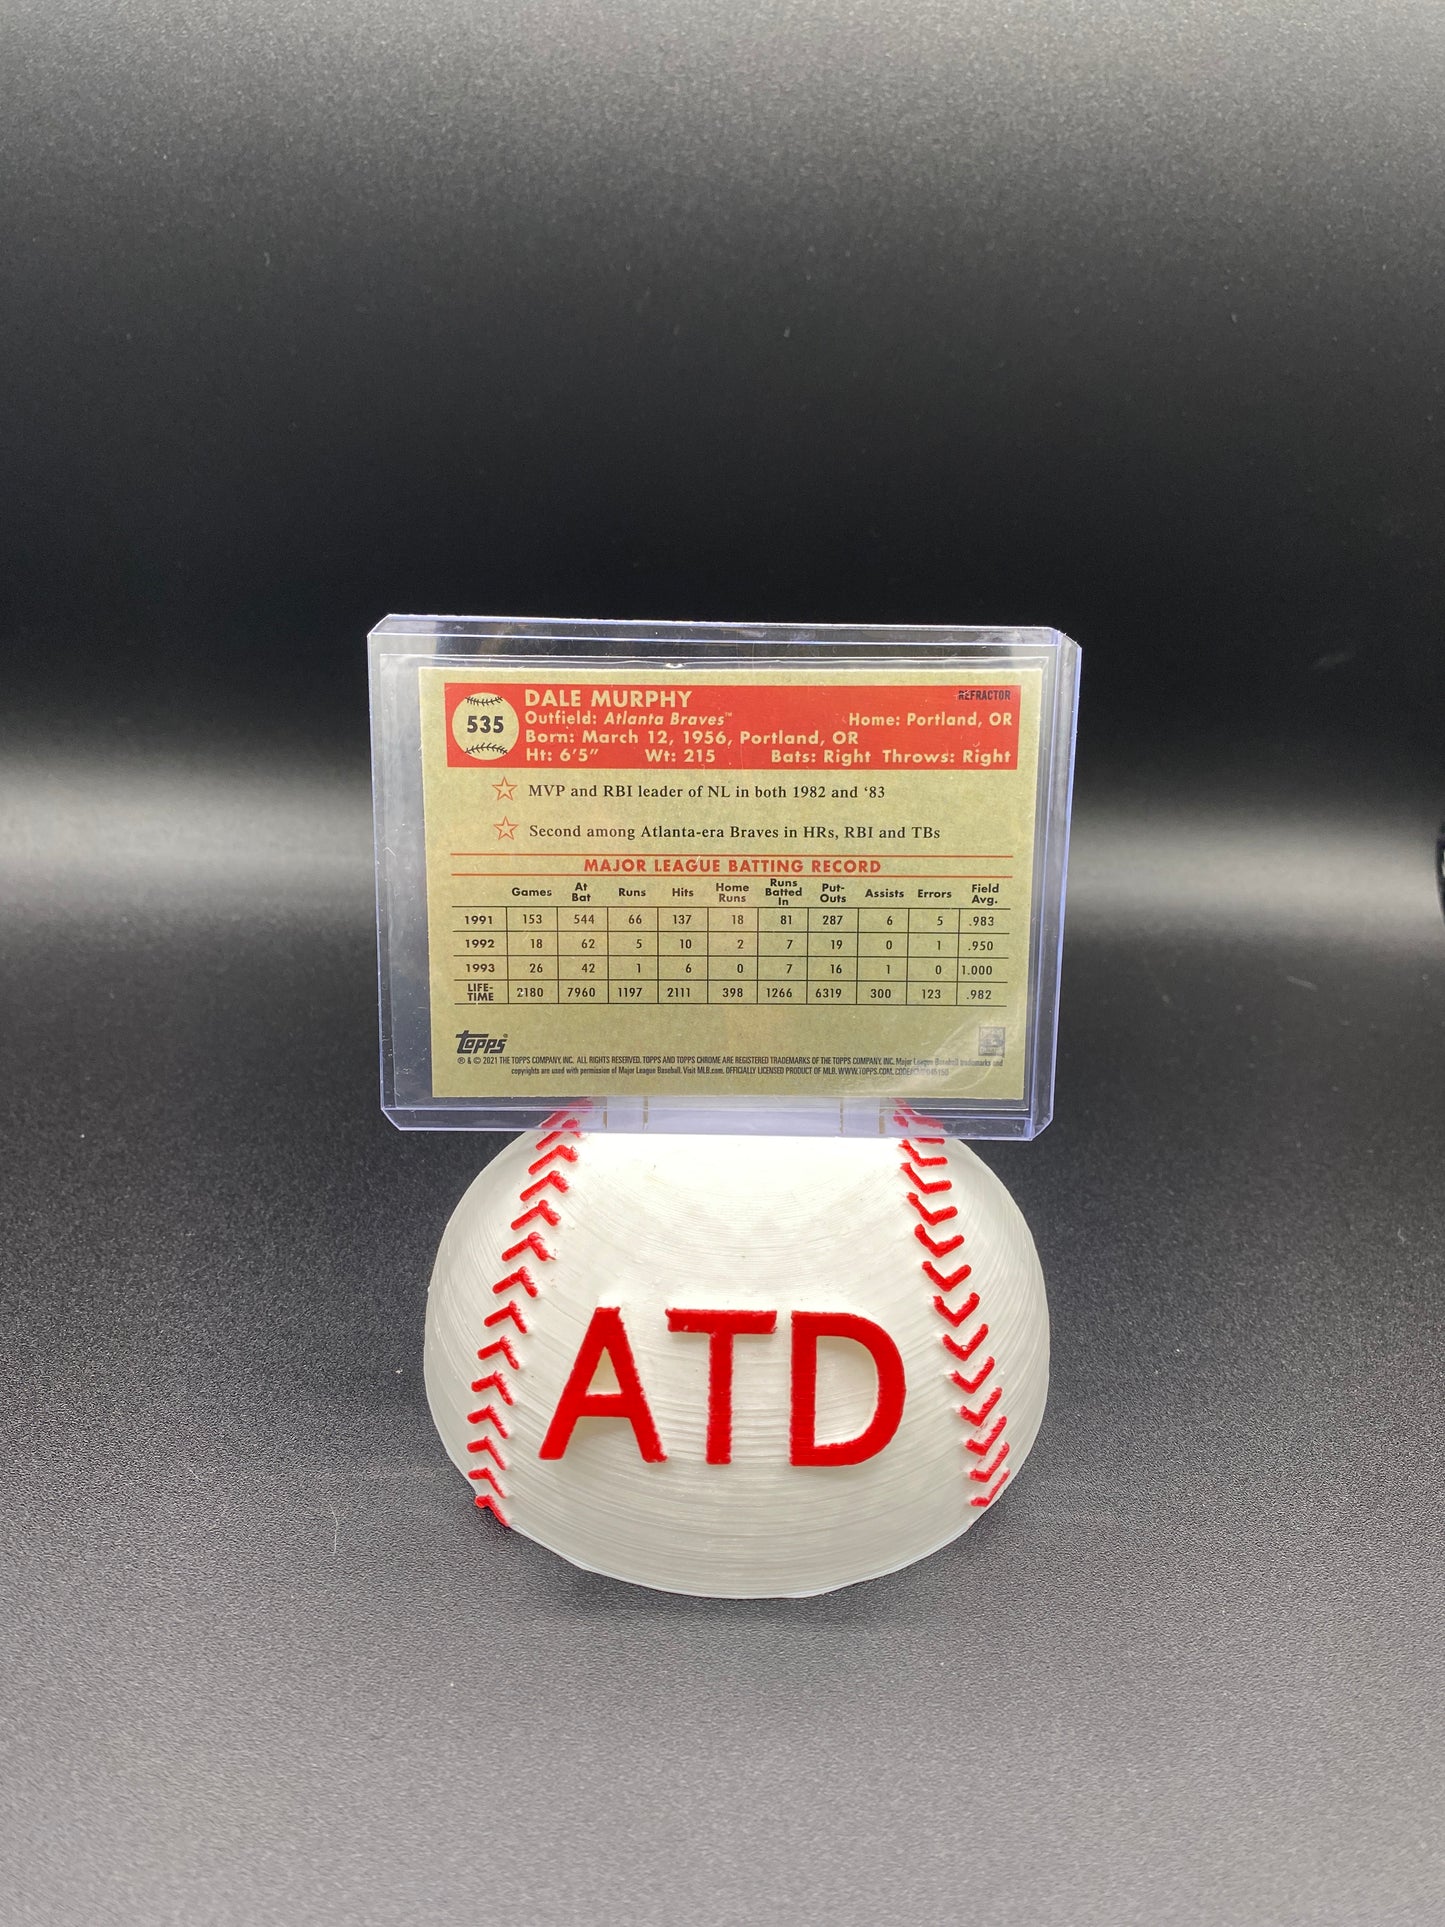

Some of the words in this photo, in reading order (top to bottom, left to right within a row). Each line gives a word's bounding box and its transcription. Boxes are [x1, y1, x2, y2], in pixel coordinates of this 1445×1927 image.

[524, 689, 581, 707] DALE
[591, 690, 692, 708] MURPHY
[959, 691, 1010, 700] REFRACTOR
[525, 711, 597, 724] Outfield:
[604, 712, 663, 725] Atlanta
[849, 713, 900, 725] Home:
[907, 713, 982, 727] Portland,
[989, 713, 1012, 726] OR
[467, 716, 504, 733] 535
[525, 730, 575, 743] Born:
[582, 731, 638, 744] March
[648, 731, 673, 745] 12,
[683, 731, 732, 746] 1956,
[740, 731, 824, 746] Portland,
[832, 732, 858, 744] OR
[526, 749, 552, 761] Ht:
[645, 750, 676, 762] Wt:
[684, 750, 716, 763] 215
[771, 750, 816, 763] Bats:
[823, 750, 871, 766] Right
[883, 750, 955, 763] Throws:
[962, 750, 1011, 766] Right
[529, 785, 565, 796] MVP
[571, 785, 597, 797] and
[604, 786, 632, 797] RBI
[639, 785, 682, 797] leader
[688, 786, 703, 797] of
[708, 786, 730, 797] NL
[736, 786, 749, 797] in
[755, 786, 786, 798] both
[793, 786, 825, 798] 1982
[831, 786, 857, 798] and
[529, 825, 581, 837] Second
[587, 827, 635, 840] among
[641, 826, 724, 838] Atlanta-era
[730, 826, 778, 837] Braves
[784, 827, 797, 838] in
[803, 827, 838, 840] HRs,
[844, 827, 874, 838] RBI
[879, 827, 905, 838] and
[912, 827, 940, 839] TBs
[584, 859, 646, 871] MAJOR
[655, 859, 720, 872] LEAGUE
[729, 860, 803, 872] BATTING
[812, 860, 881, 873] RECORD
[575, 883, 587, 892] At
[716, 883, 749, 892] Home
[770, 878, 798, 887] Runs
[512, 888, 552, 897] Games
[618, 888, 646, 897] Runs
[672, 888, 694, 897] Hits
[765, 887, 802, 897] Batted
[822, 884, 845, 893] Put-
[865, 889, 904, 898] Assists
[972, 884, 999, 893] Field
[572, 893, 591, 902] Bat
[719, 894, 746, 902] Runs
[820, 894, 846, 903] Outs
[918, 889, 952, 899] Errors
[778, 898, 789, 906] In
[972, 895, 998, 906] Avg.
[464, 916, 493, 924] 1991
[523, 915, 542, 924] 153
[574, 915, 594, 924] 544
[629, 915, 642, 924] 66
[672, 915, 691, 924] 137
[732, 915, 744, 924] 18
[780, 916, 792, 925] 81
[823, 915, 843, 925] 287
[887, 916, 893, 926] 6
[937, 916, 943, 926] 5
[968, 917, 994, 926] .983
[465, 940, 495, 948] 1992
[530, 939, 543, 948] 18
[582, 939, 595, 948] 62
[636, 939, 642, 948] 5
[679, 939, 692, 949] 10
[737, 940, 744, 949] 2
[786, 940, 793, 949] 7
[831, 940, 843, 950] 19
[886, 940, 892, 950] 0
[937, 941, 941, 950] 1
[968, 941, 993, 951] .950
[466, 964, 495, 973] 1993
[530, 963, 543, 973] 26
[582, 963, 595, 973] 42
[637, 964, 641, 973] 1
[686, 963, 692, 973] 6
[737, 964, 743, 973] 0
[786, 964, 793, 974] 7
[830, 964, 842, 974] 16
[886, 965, 891, 974] 1
[935, 965, 942, 975] 0
[962, 965, 992, 975] 1.000
[468, 984, 493, 992] LIFE-
[467, 993, 494, 1001] TIME
[517, 988, 544, 997] 2180
[568, 988, 596, 997] 7960
[618, 988, 642, 997] 1197
[667, 988, 690, 997] 2111
[723, 988, 743, 997] 398
[766, 988, 792, 998] 1266
[815, 988, 842, 998] 6319
[870, 989, 891, 999] 300
[922, 989, 941, 999] 123
[966, 990, 992, 1000] .982
[770, 1056, 810, 1064] TRADEMARKS
[580, 1067, 610, 1075] permission
[619, 1067, 635, 1075] Major
[636, 1067, 656, 1075] League
[538, 1306, 906, 1467] ATD
